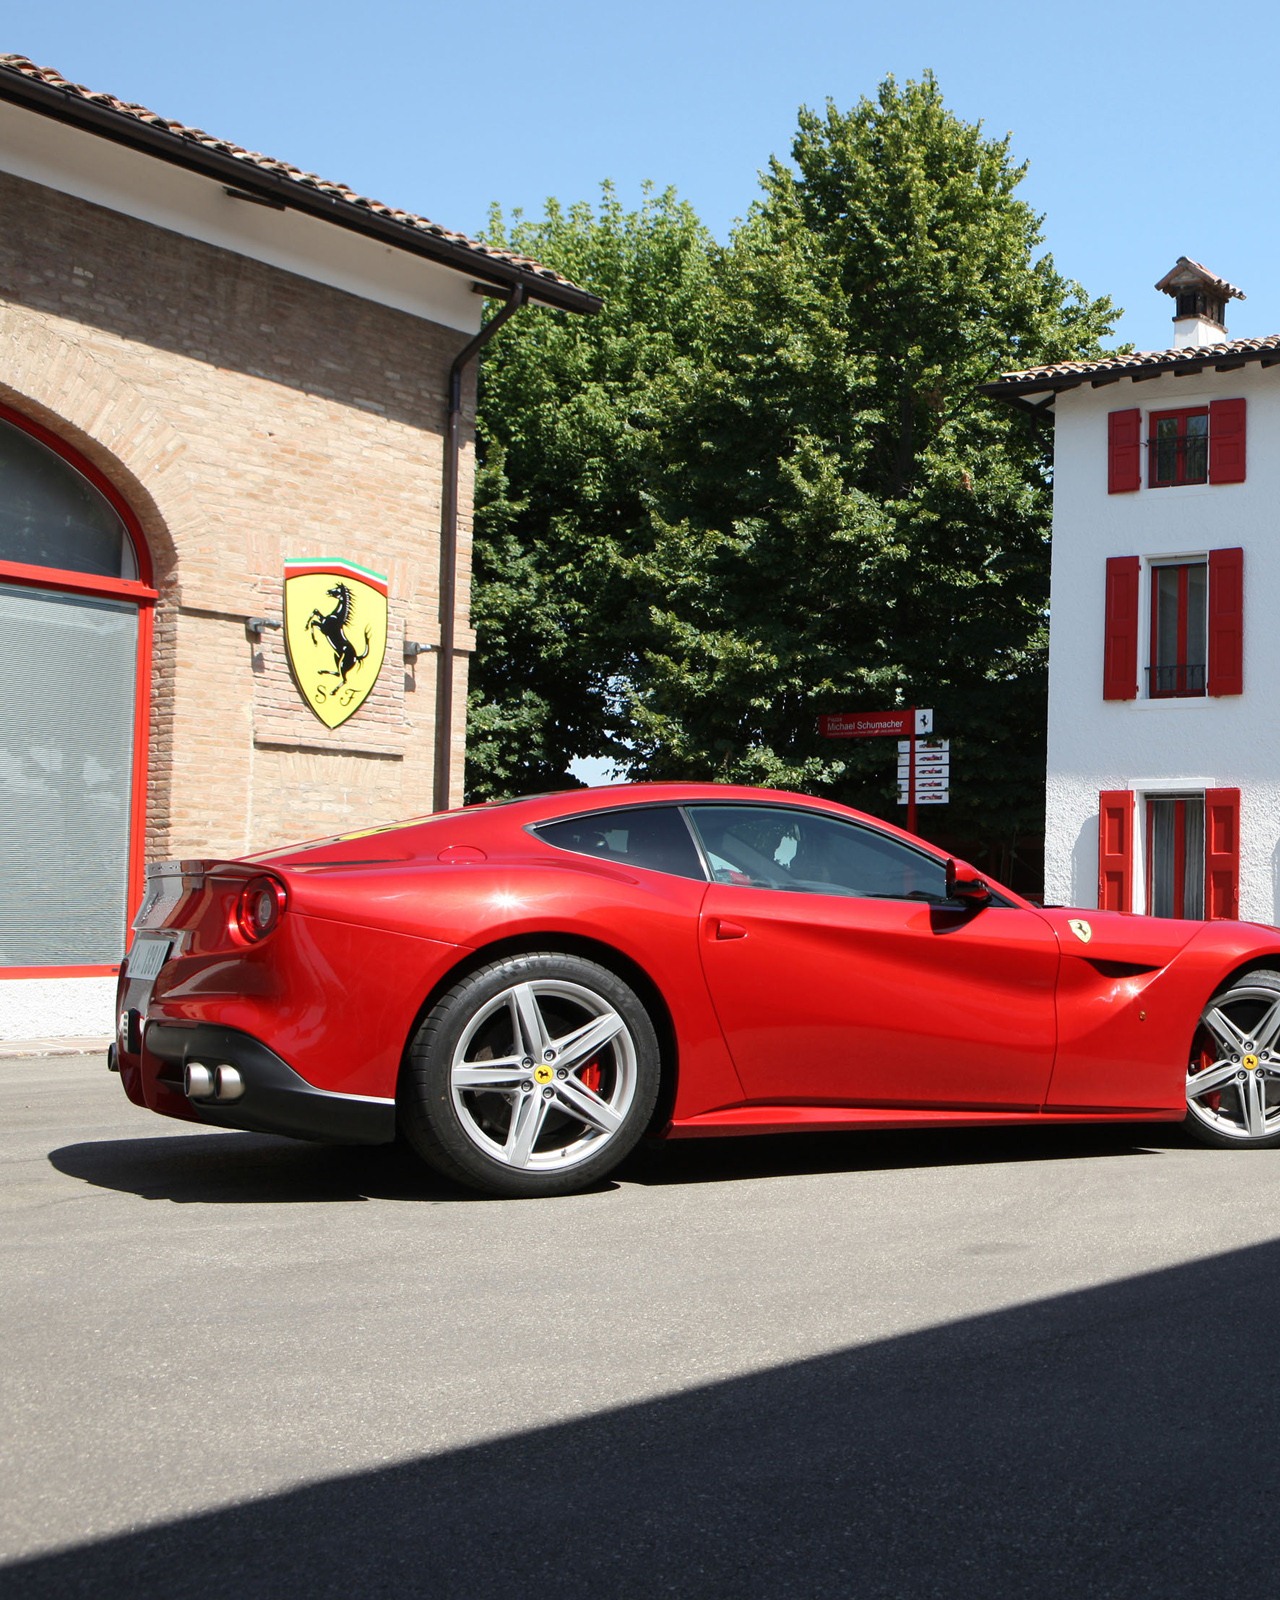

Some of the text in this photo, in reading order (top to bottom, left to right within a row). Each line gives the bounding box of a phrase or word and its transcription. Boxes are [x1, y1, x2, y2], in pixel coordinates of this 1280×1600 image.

[314, 684, 362, 707] S F
[827, 720, 903, 731] Michael Schumacher
